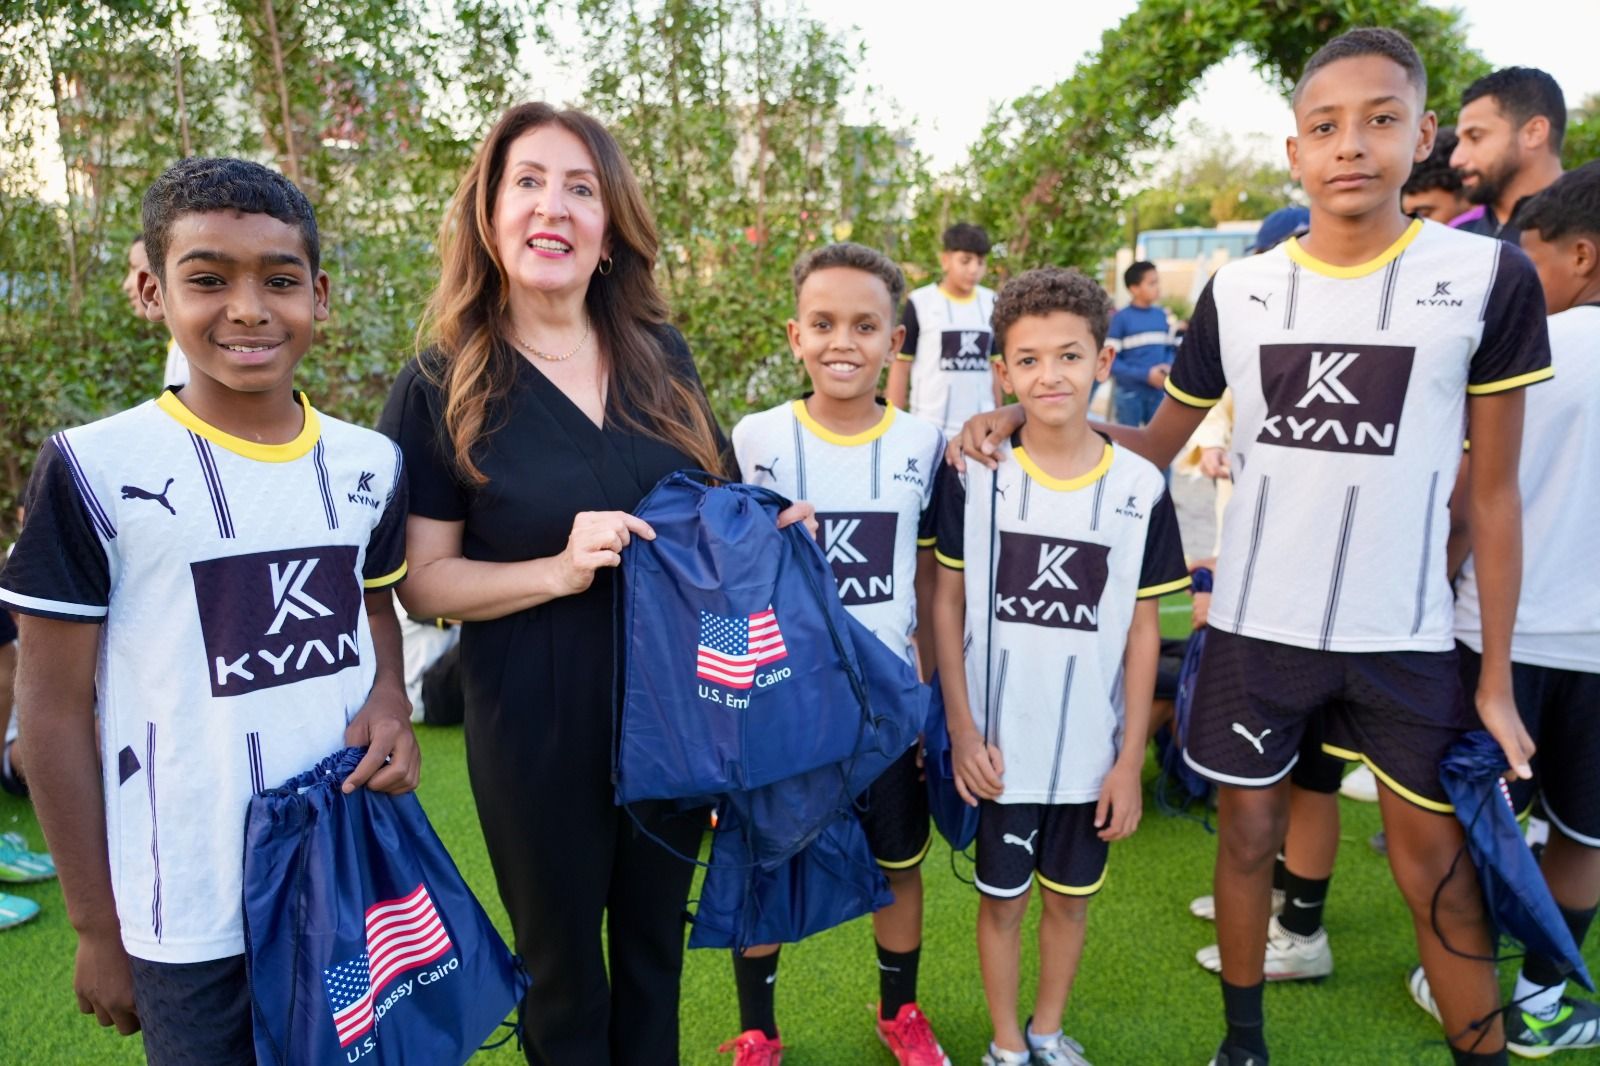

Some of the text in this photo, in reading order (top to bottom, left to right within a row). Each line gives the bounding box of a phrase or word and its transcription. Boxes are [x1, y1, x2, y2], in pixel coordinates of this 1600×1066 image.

[1415, 299, 1463, 307] KYAN
[941, 357, 988, 370] KYAN
[1261, 415, 1395, 447] KYAN
[893, 473, 924, 487] KYAN
[347, 493, 380, 509] KYAN
[834, 574, 892, 598] AN
[996, 593, 1097, 625] KYAN
[216, 630, 359, 686] KYAN
[698, 684, 722, 703] U.S.
[755, 667, 791, 688] Cairo
[347, 1037, 376, 1063] U.S.
[417, 957, 459, 985] Cairo
